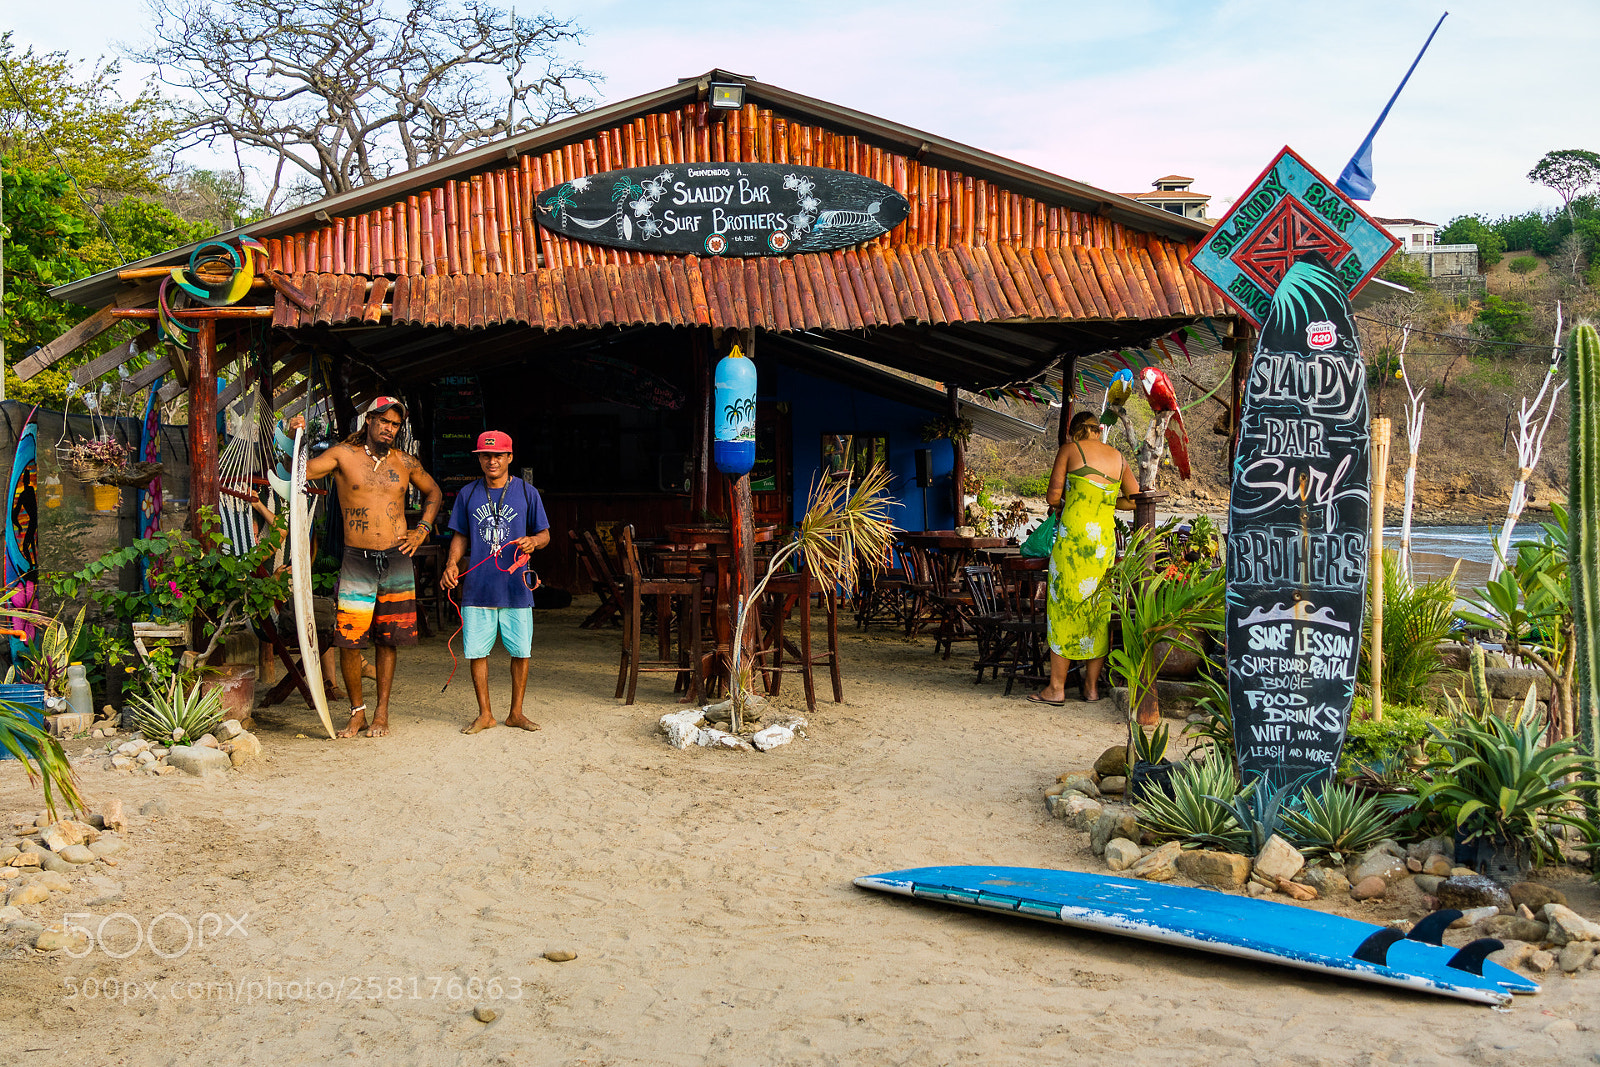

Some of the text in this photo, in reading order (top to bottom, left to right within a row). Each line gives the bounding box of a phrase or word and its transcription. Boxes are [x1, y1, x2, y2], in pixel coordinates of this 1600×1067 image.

[687, 168, 731, 178] BIENVENIDOS
[673, 178, 771, 206] SLAUDY BAR
[662, 207, 789, 235] SURF BROTHERS
[1210, 166, 1356, 260] SLAUDY BAR
[1312, 333, 1331, 343] 420
[1247, 353, 1364, 419] SLAUDY
[1261, 418, 1330, 458] BAR
[1231, 455, 1369, 534] Surf
[345, 507, 370, 519] FUCK
[349, 519, 369, 535] OFF
[1233, 526, 1367, 588] BROTHERS
[1248, 623, 1354, 658] SURF LESSON
[1260, 674, 1313, 690] BOOGIE
[1308, 655, 1356, 681] RENTAL
[1244, 690, 1308, 710] FOOD
[1262, 702, 1341, 734] DRINKS
[1250, 745, 1334, 764] LEASH AND MORE
